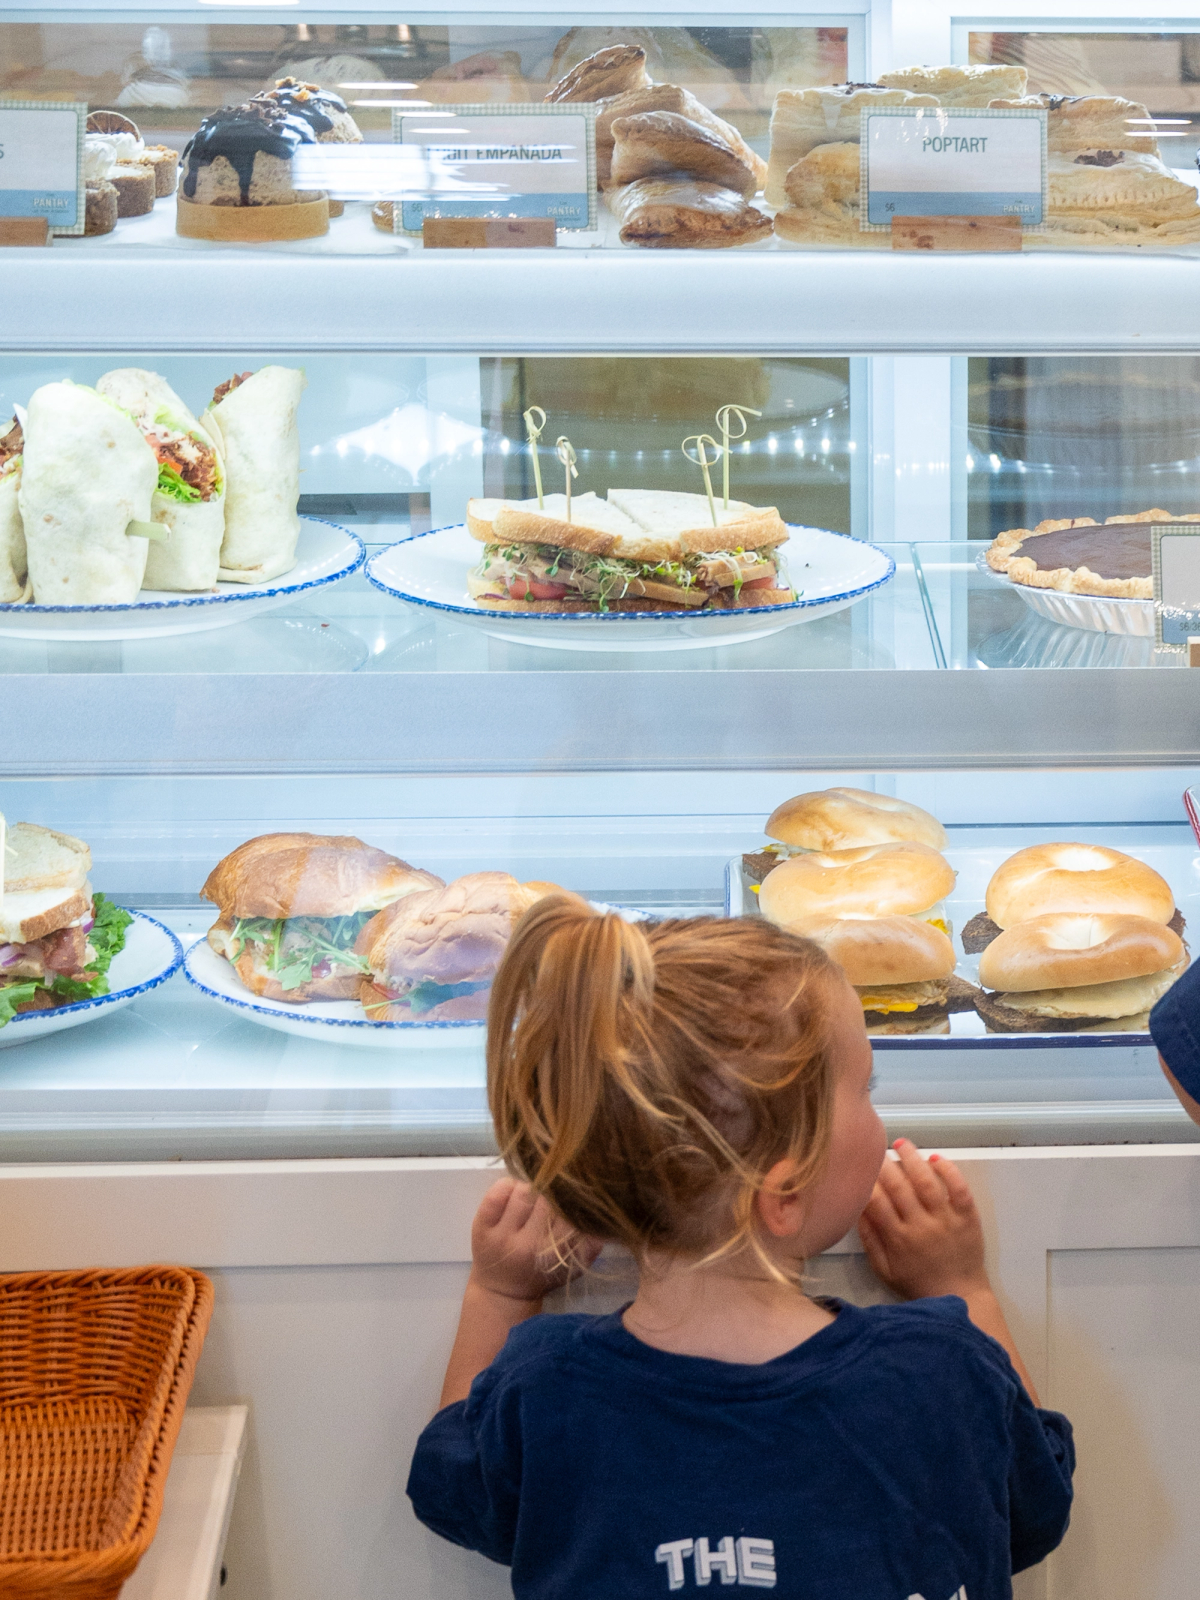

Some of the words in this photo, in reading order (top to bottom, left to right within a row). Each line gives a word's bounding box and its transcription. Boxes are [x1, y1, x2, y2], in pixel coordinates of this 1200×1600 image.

[922, 136, 988, 153] POPTART
[33, 197, 69, 209] PANTRY
[1003, 204, 1035, 214] PANTRY
[546, 206, 581, 217] PANTRY
[655, 1536, 777, 1591] THE
